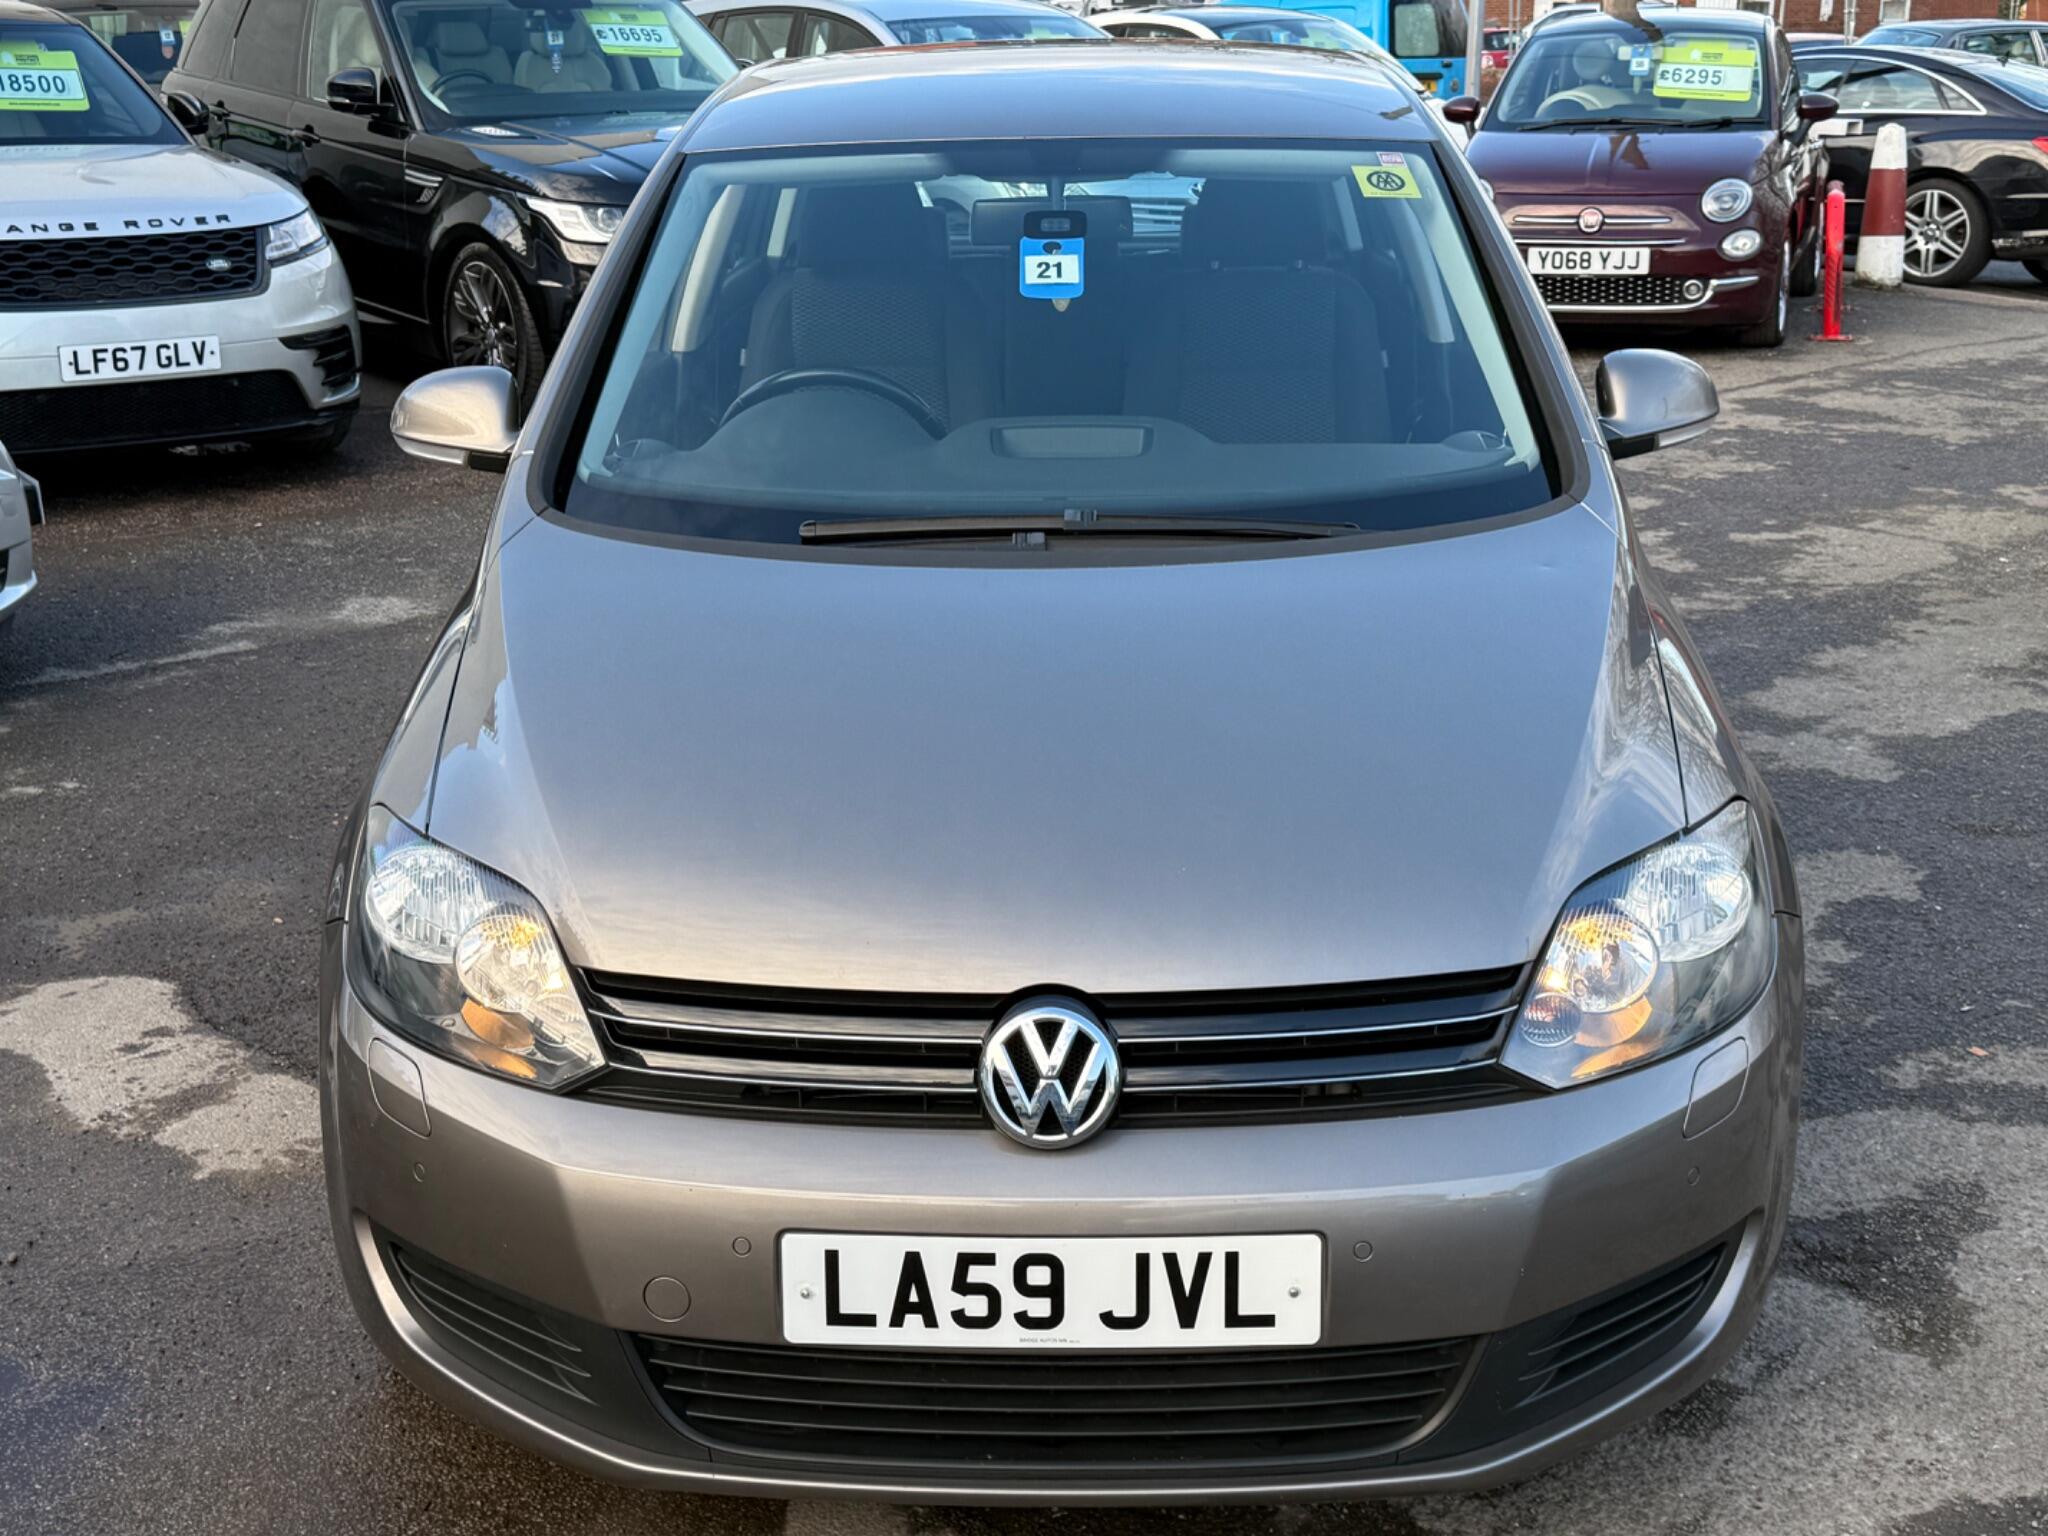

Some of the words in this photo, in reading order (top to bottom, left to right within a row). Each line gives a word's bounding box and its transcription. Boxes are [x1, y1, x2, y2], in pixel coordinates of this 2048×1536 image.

[1660, 67, 1722, 85] £6295
[123, 214, 231, 230] ROVER
[1599, 250, 1640, 270] YJJ
[1036, 261, 1062, 279] 21
[72, 346, 147, 376] LF67
[156, 340, 206, 369] GLV
[824, 1249, 1065, 1330] LA59
[1099, 1251, 1276, 1330] JVL
